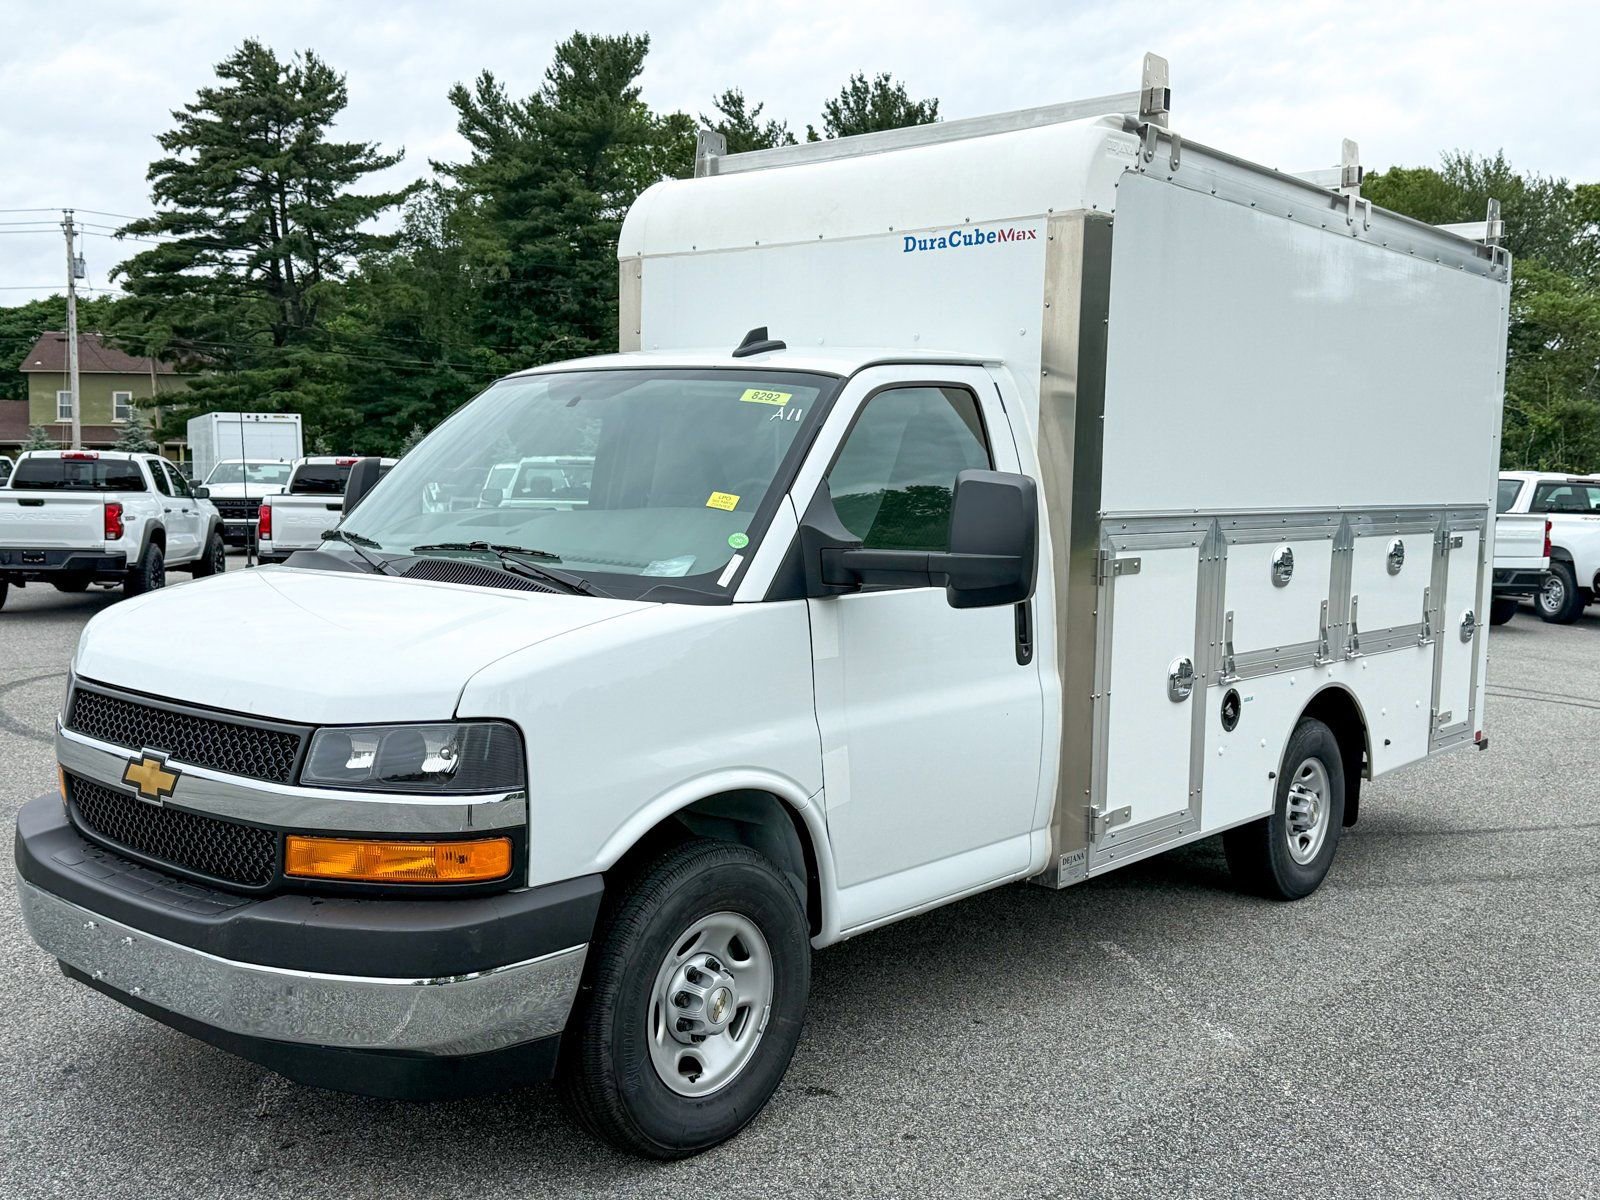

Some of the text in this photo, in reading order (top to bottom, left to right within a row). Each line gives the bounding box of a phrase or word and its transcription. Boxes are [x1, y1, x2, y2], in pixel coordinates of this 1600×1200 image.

[903, 228, 1037, 252] DuraCubeMax
[751, 391, 781, 402] 8292
[1062, 852, 1085, 866] DEJANA
